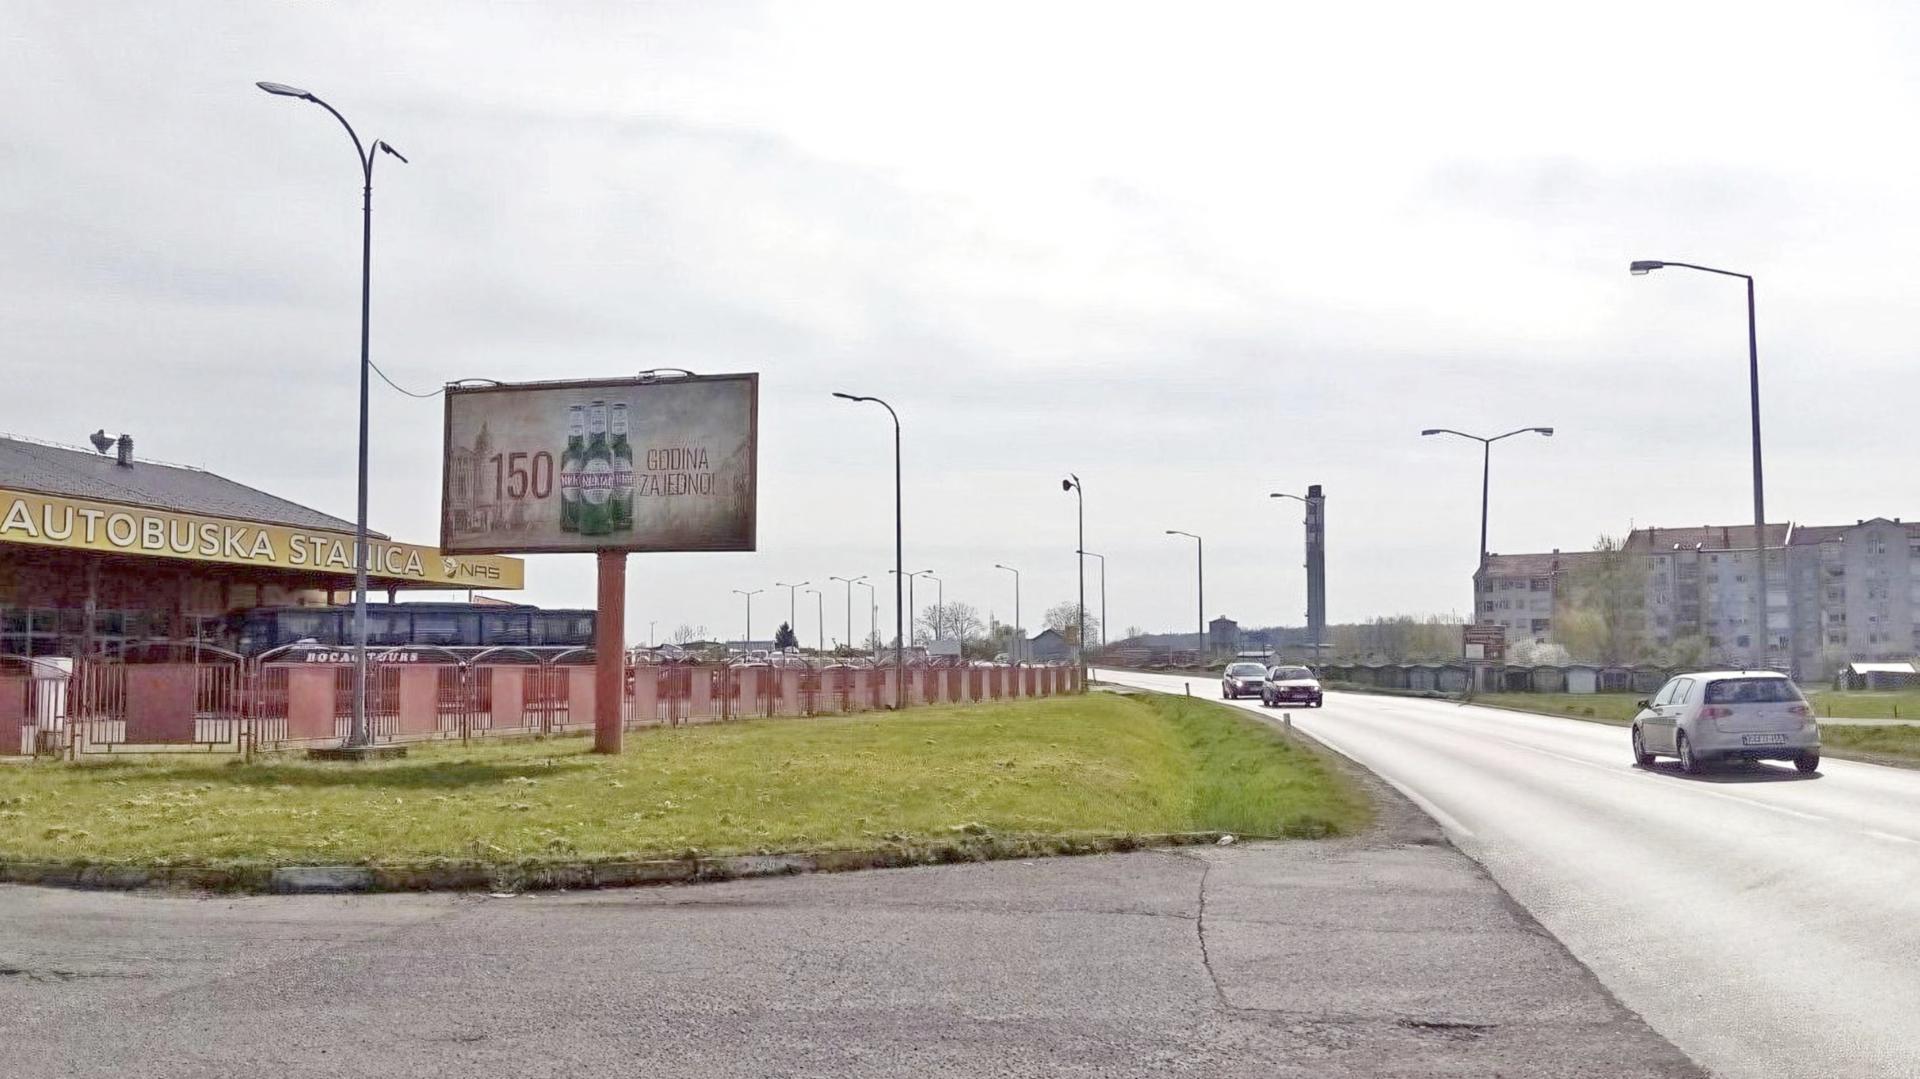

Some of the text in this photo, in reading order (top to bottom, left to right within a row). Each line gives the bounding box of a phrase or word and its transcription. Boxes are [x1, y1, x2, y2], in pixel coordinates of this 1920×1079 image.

[647, 447, 709, 471] GODINA
[489, 451, 554, 501] 150
[640, 472, 716, 497] ZAJEDNO!
[0, 499, 424, 577] AUTOBUSKA STANICA
[460, 562, 500, 580] NAS
